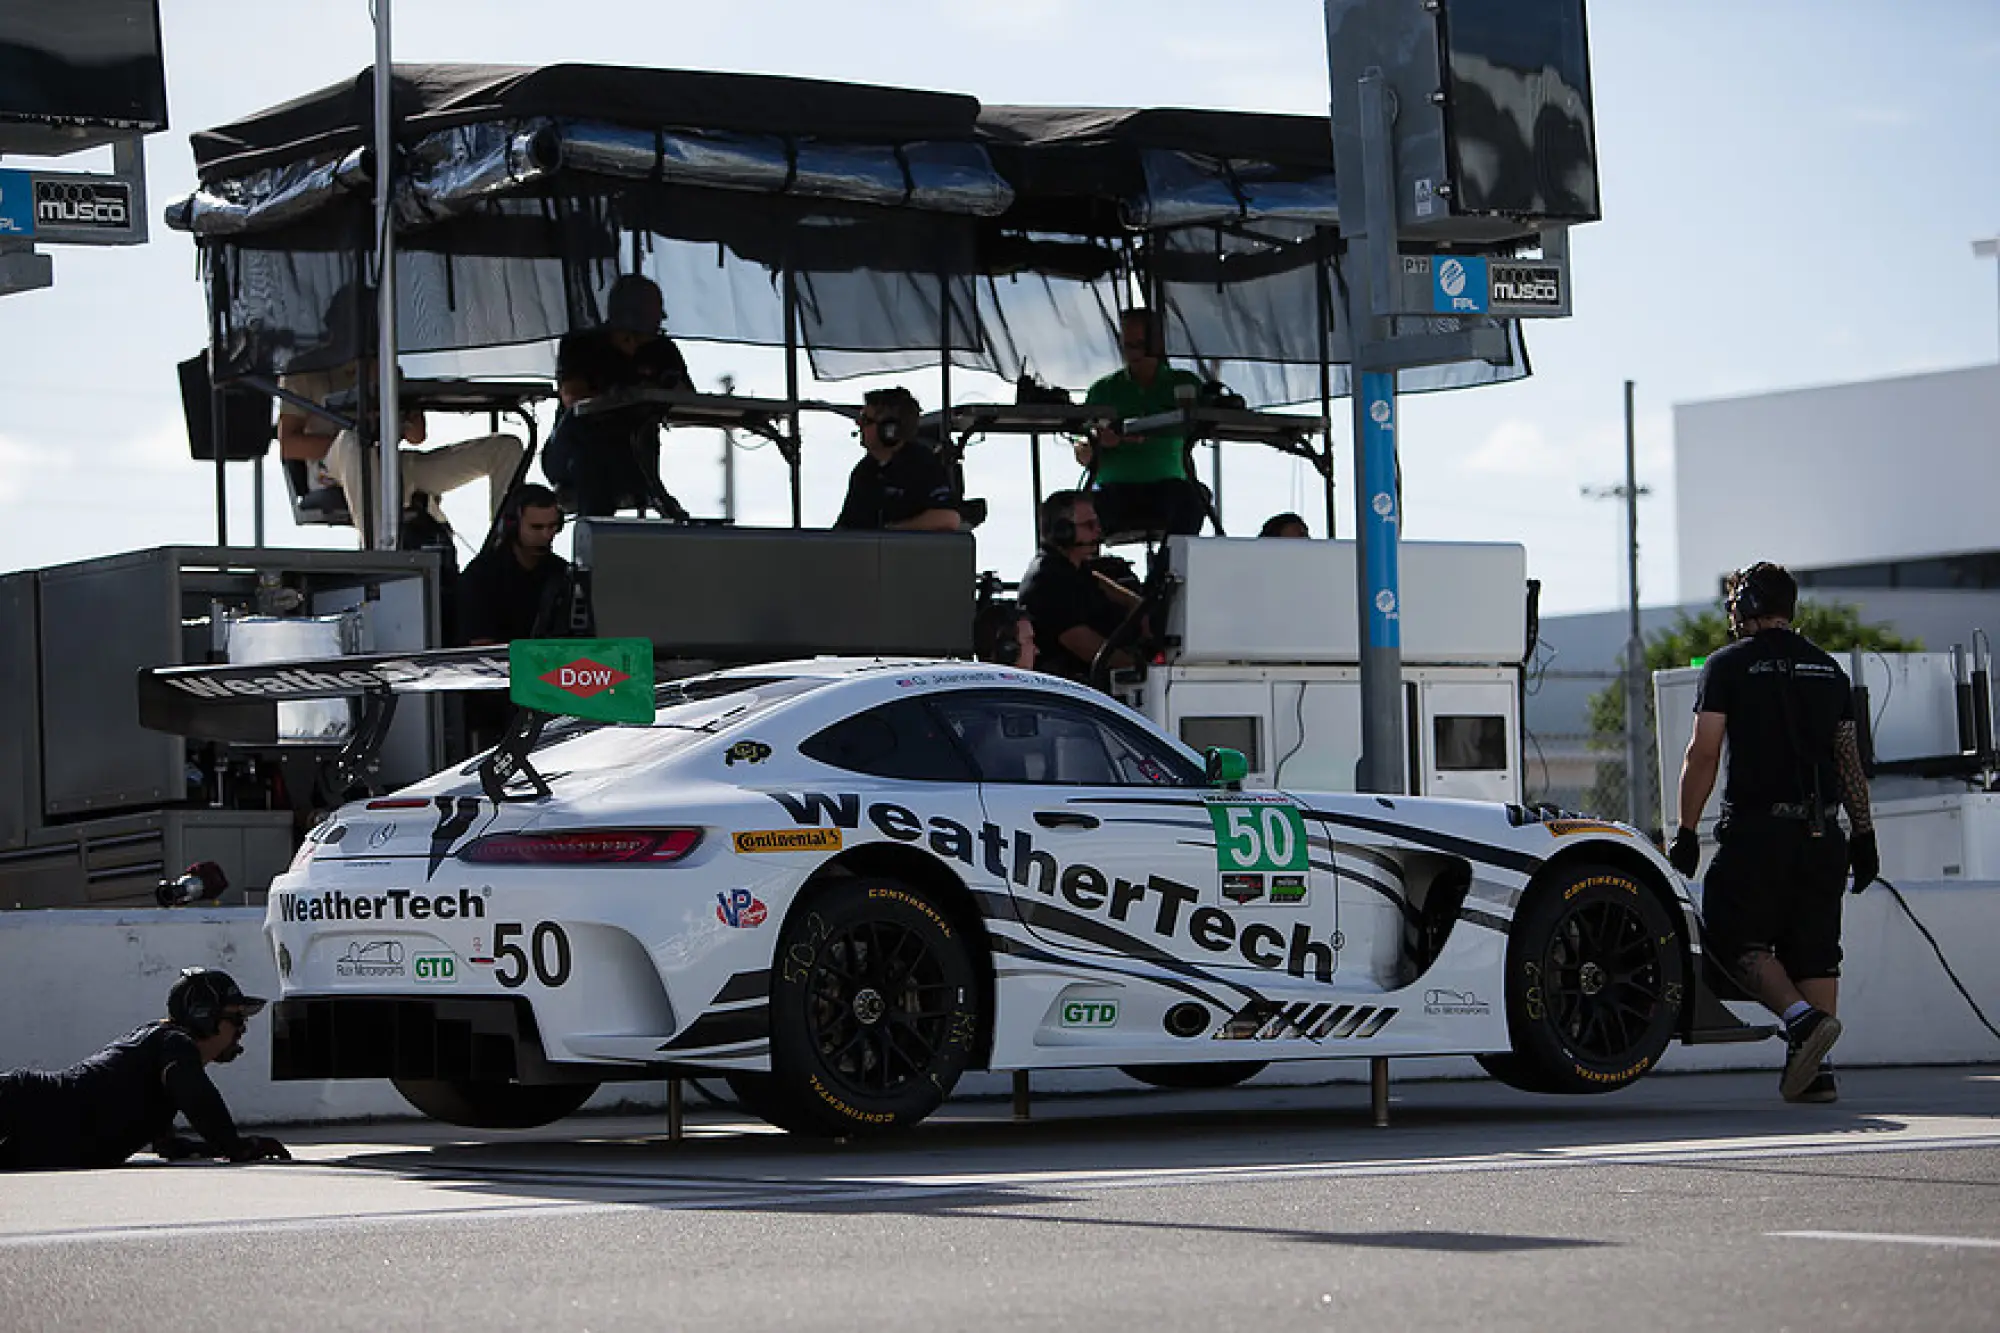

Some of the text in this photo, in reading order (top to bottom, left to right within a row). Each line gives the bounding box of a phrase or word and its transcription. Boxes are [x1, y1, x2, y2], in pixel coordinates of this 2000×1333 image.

[39, 201, 125, 221] musco
[1494, 283, 1556, 299] musco
[1226, 807, 1295, 867] 50
[279, 887, 486, 922] WeatherTech
[769, 792, 1334, 984] WeatherTech
[1564, 875, 1640, 900] CONTINENTAL
[716, 888, 752, 928] VP
[868, 888, 953, 939] CONTINENTAL
[414, 956, 456, 979] GTD
[494, 920, 571, 988] 50
[1063, 1004, 1116, 1024] GTD
[809, 1073, 896, 1124] CONTINENTAL
